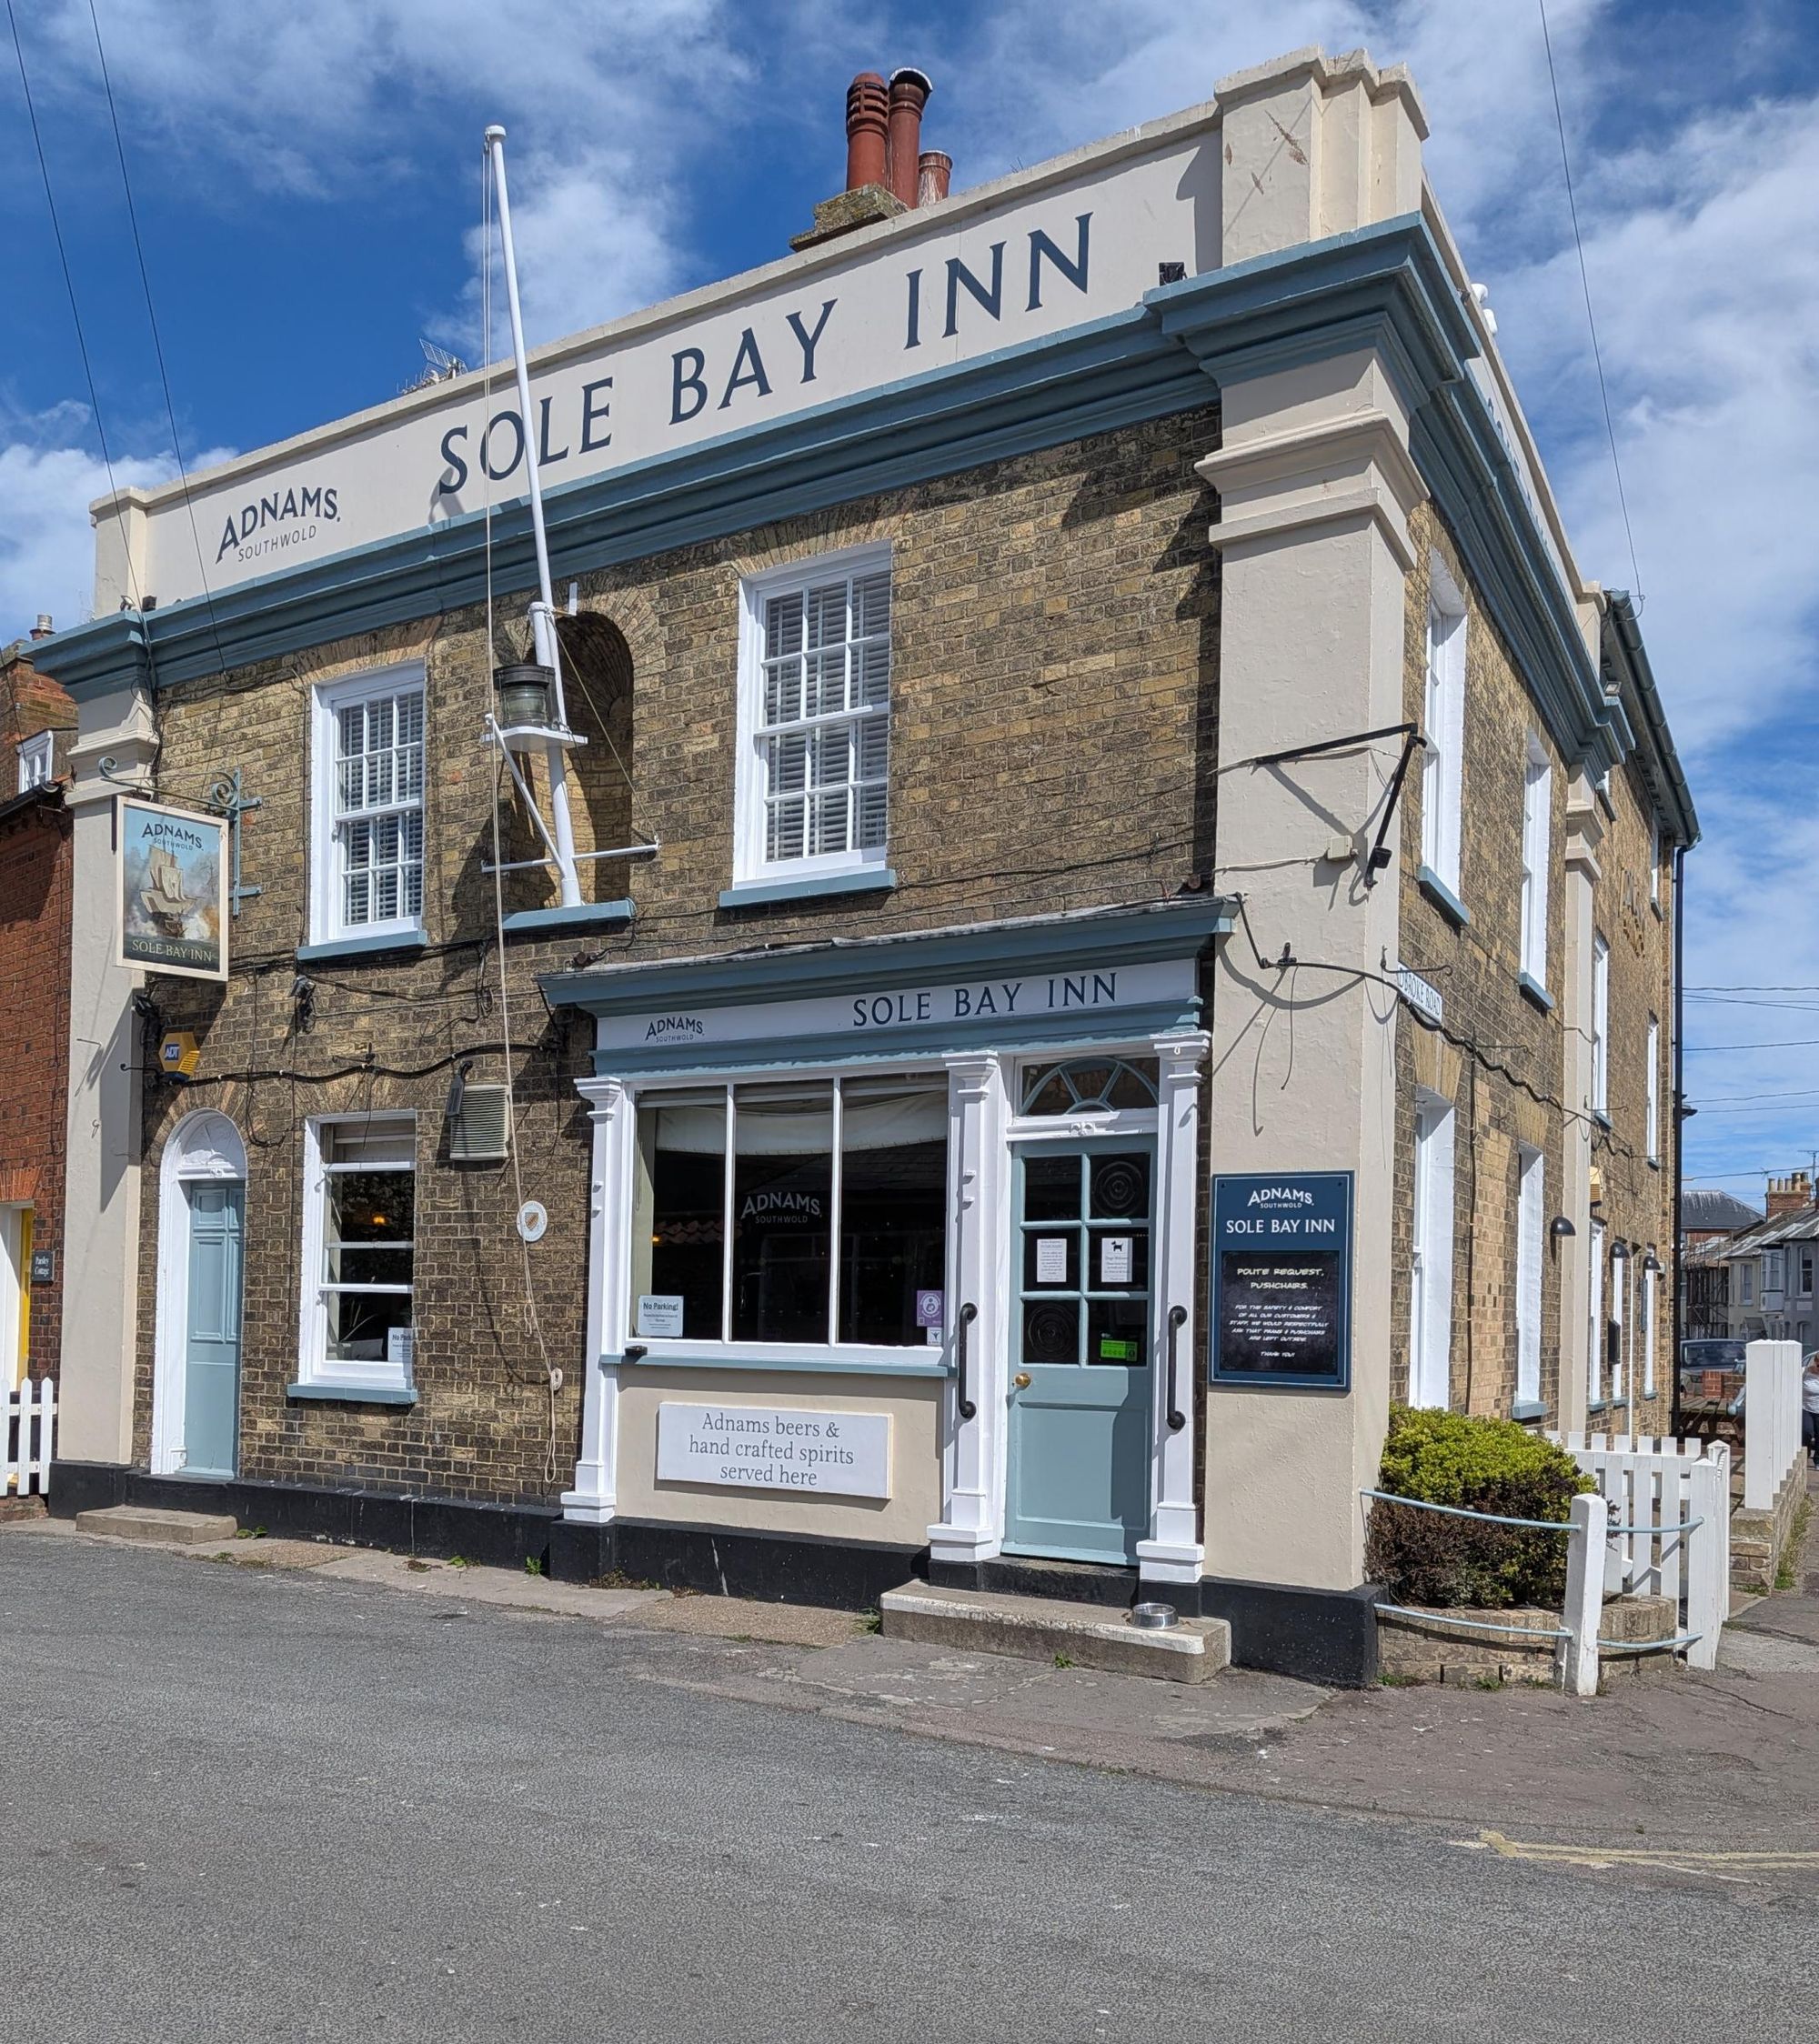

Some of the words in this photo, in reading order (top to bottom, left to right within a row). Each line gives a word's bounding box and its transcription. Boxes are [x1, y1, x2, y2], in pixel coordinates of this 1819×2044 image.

[439, 376, 613, 496] SOLE
[668, 298, 838, 425] BAY
[904, 212, 1093, 350] INN
[237, 525, 317, 562] SOUTHWOLD
[153, 837, 194, 851] SOUTHWOLD
[132, 939, 163, 955] SOLE
[166, 945, 188, 958] BAY
[190, 948, 212, 962] INN
[853, 992, 931, 1027] SOLE
[954, 983, 1023, 1017] BAY
[1048, 972, 1117, 1007] INN
[656, 1034, 694, 1043] SOUTHWOLD
[165, 1047, 179, 1057] ADT
[755, 1215, 808, 1224] SOUTHWOLD
[1226, 1219, 1264, 1234] SOLE
[1271, 1219, 1301, 1233] BAY
[1305, 1218, 1335, 1233] INN
[702, 1413, 769, 1434] Adnams
[775, 1416, 820, 1437] beers
[826, 1421, 839, 1438] &
[689, 1434, 729, 1456] hand
[735, 1439, 794, 1459] crafted
[799, 1445, 854, 1467] spirits
[720, 1464, 773, 1482] served
[779, 1465, 818, 1486] here
